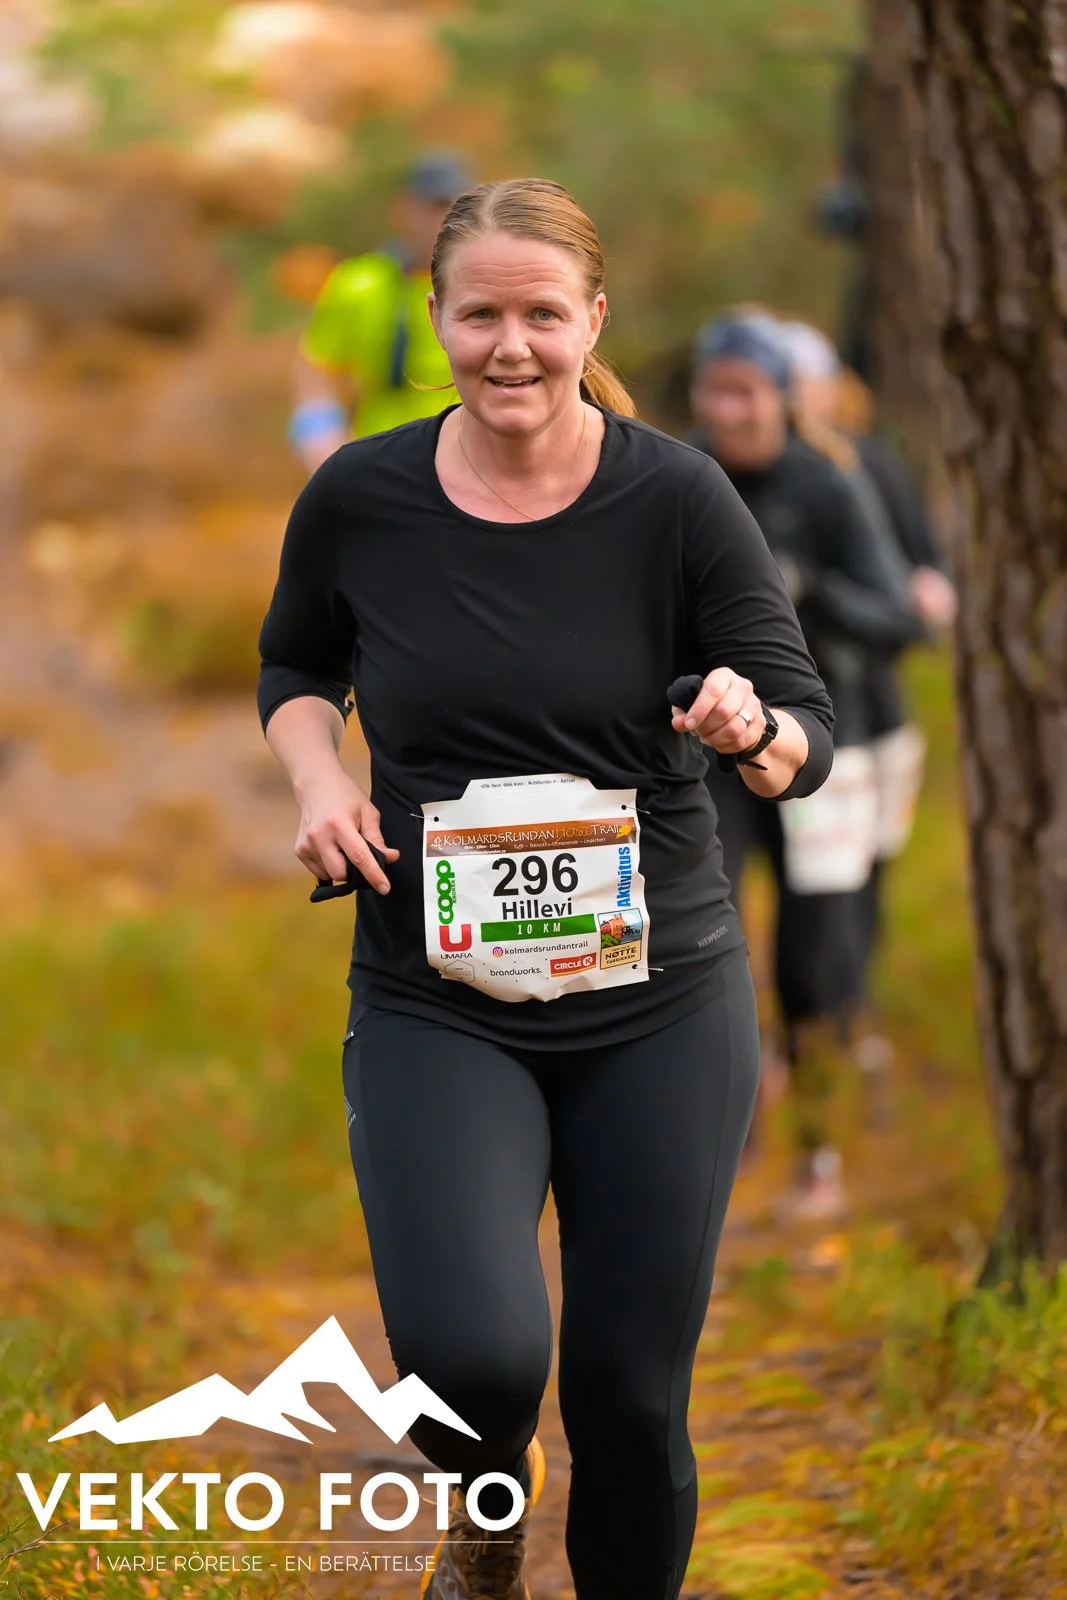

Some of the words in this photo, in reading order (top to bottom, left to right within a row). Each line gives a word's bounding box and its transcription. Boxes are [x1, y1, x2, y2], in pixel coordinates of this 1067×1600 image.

[491, 852, 579, 897] 296
[617, 846, 632, 907] Aktivitus
[436, 860, 455, 925] coop
[502, 897, 573, 920] Hillevi
[517, 923, 532, 935] 10
[543, 922, 561, 933] KM
[440, 952, 473, 960] UMARA
[504, 940, 588, 955] kolmardsrundantrail
[553, 960, 582, 971] CIRCLE
